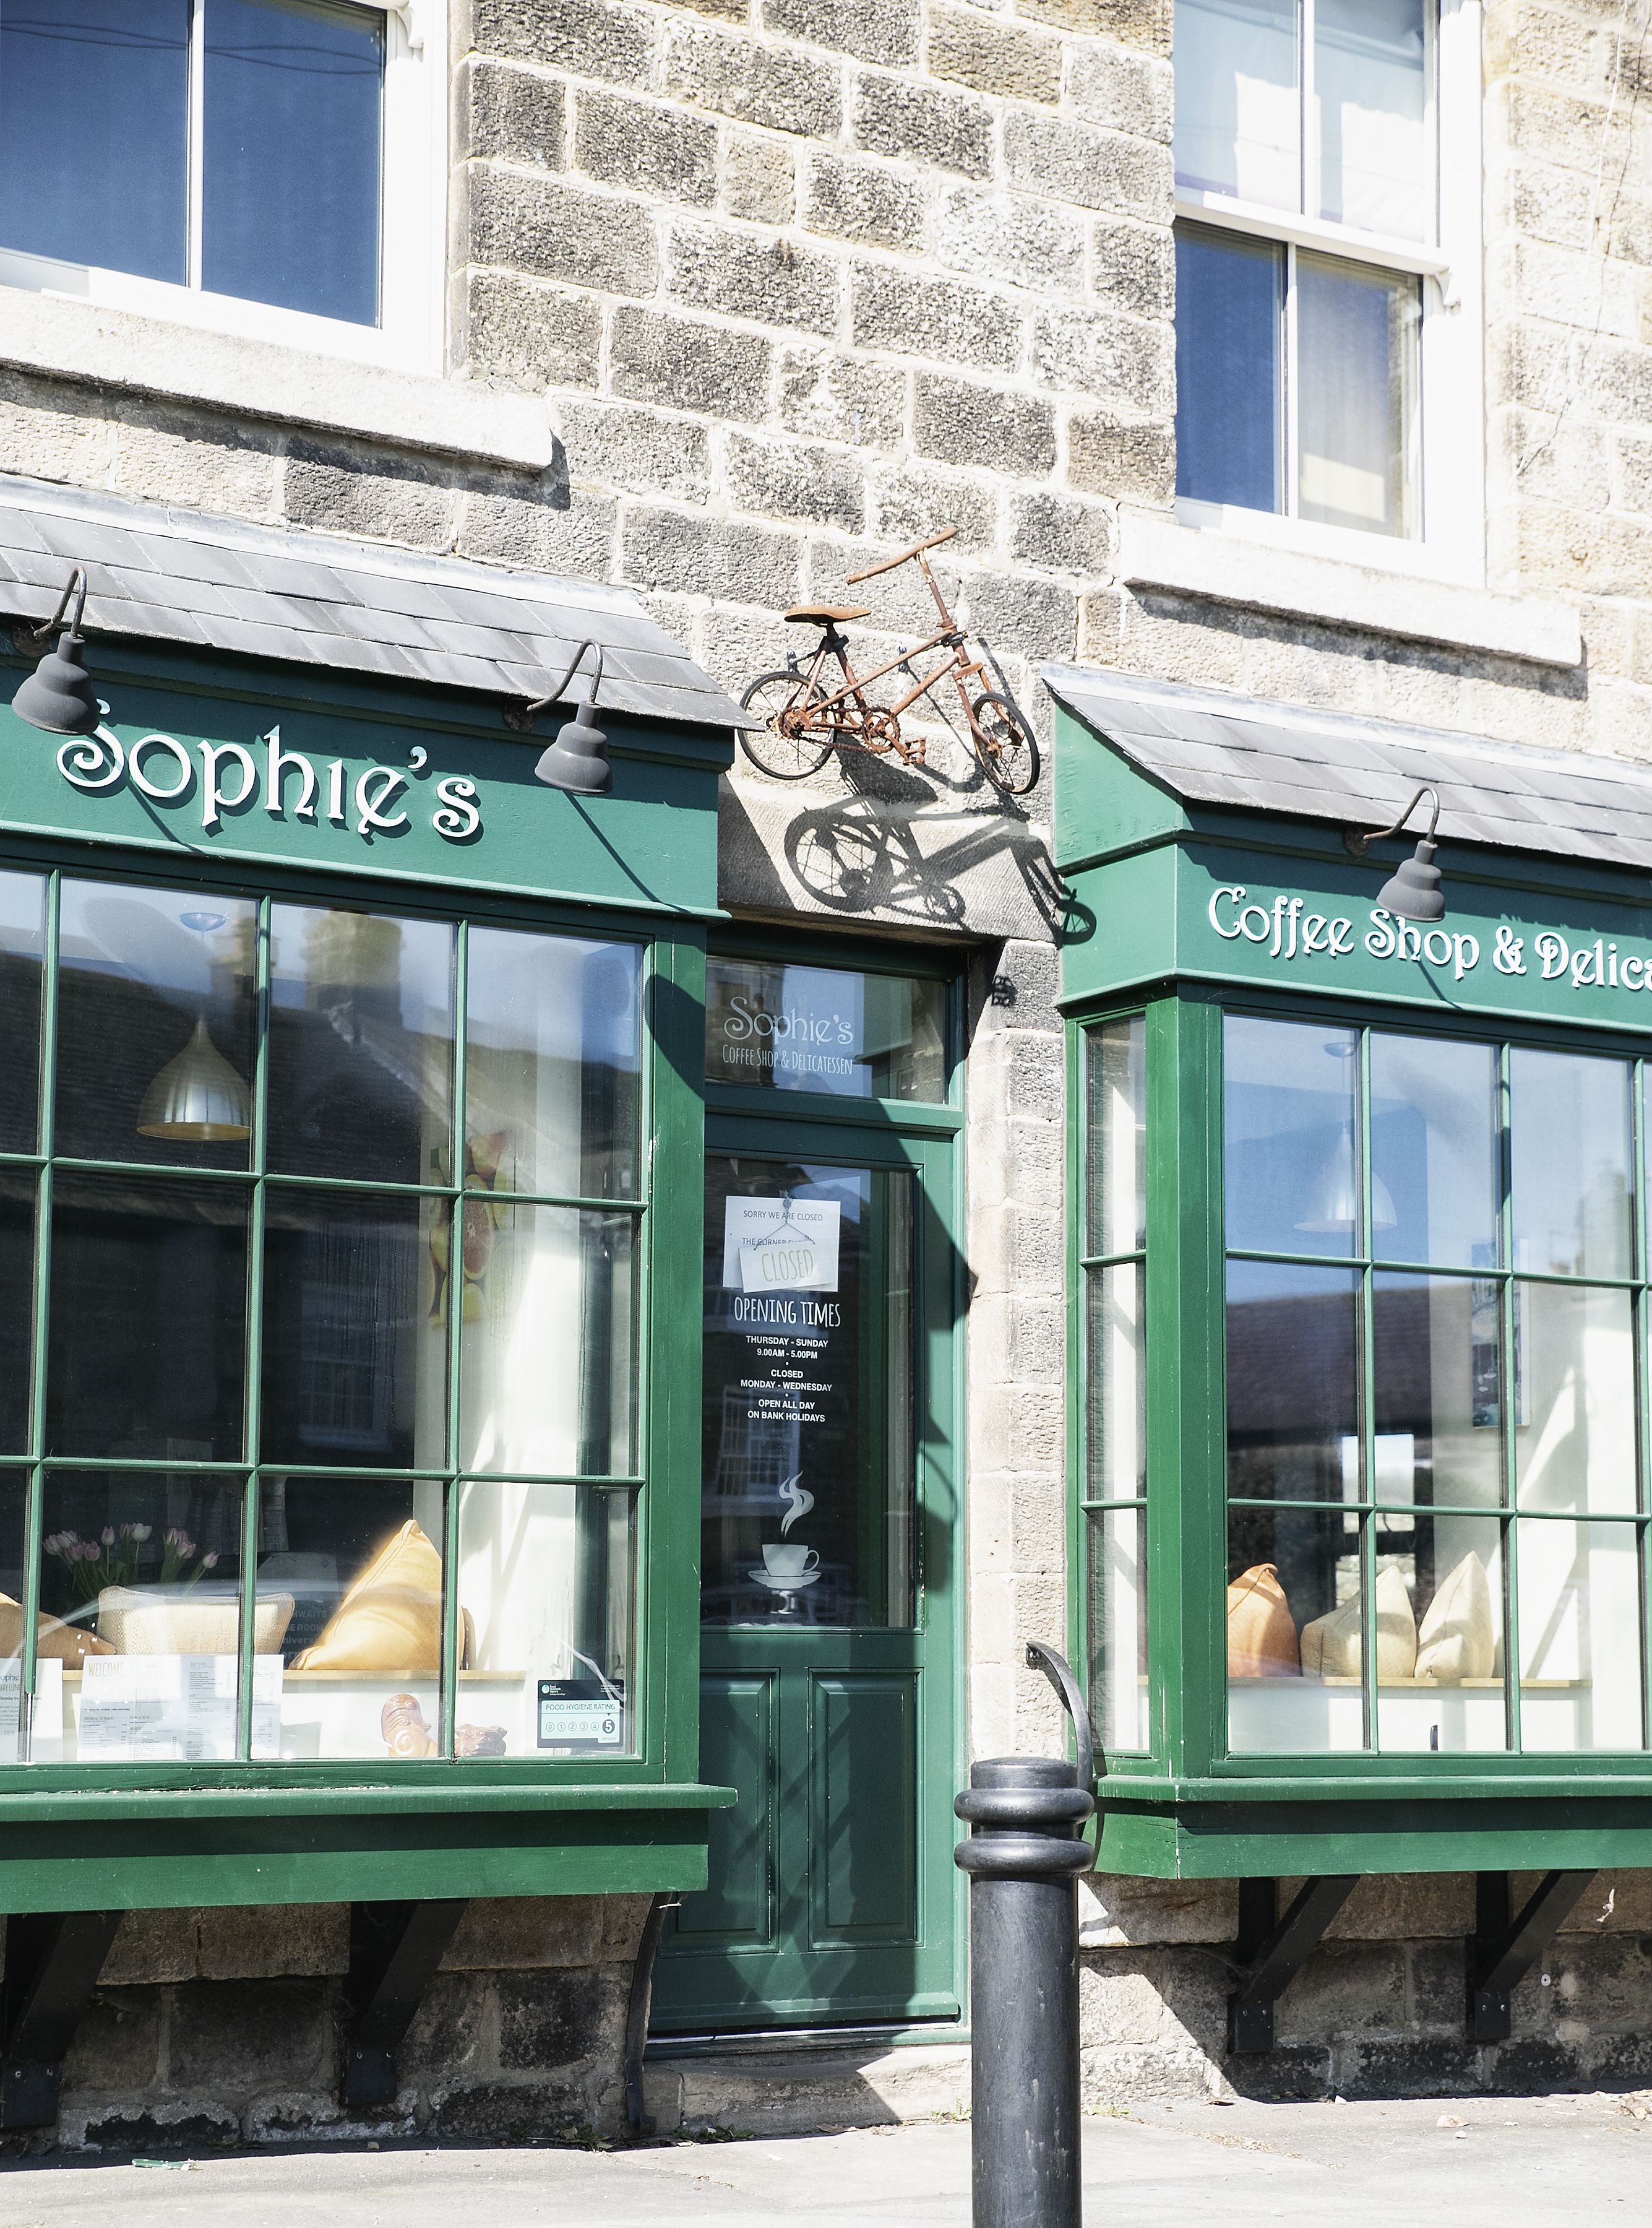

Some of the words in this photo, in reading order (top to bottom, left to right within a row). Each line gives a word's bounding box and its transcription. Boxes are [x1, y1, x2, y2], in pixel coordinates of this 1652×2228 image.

[56, 698, 480, 839] Sophie's
[1208, 886, 1354, 959] Coffee
[1364, 908, 1480, 980] Shop
[1492, 925, 1526, 975] &
[724, 996, 854, 1046] Sophie's
[723, 1044, 754, 1066] COFFEE
[757, 1047, 778, 1068] SHOP
[780, 1050, 789, 1069] &
[792, 1051, 853, 1075] DELICATESSEN
[742, 1210, 767, 1219] SORRY
[768, 1211, 780, 1219] WE
[781, 1212, 795, 1220] ARE
[797, 1212, 823, 1221] CLOSED
[742, 1237, 755, 1245] THE
[761, 1248, 814, 1283] CLOSED
[734, 1297, 797, 1324] OPENING
[799, 1301, 841, 1328] TIMES
[746, 1335, 789, 1345] THURSDAY
[796, 1338, 828, 1348] SUNDAY
[757, 1348, 785, 1357] 9.00AM
[791, 1350, 818, 1359] 5.00PM
[770, 1369, 804, 1378] CLOSED
[740, 1380, 776, 1389] MONDAY
[782, 1381, 833, 1392] WEDNESDAY
[758, 1399, 781, 1408] OPEN
[782, 1401, 798, 1409] ALL
[799, 1401, 815, 1410] DAY
[761, 1411, 785, 1420] BANK
[786, 1412, 825, 1422] HOLIDAYS
[604, 1721, 613, 1732] 5
